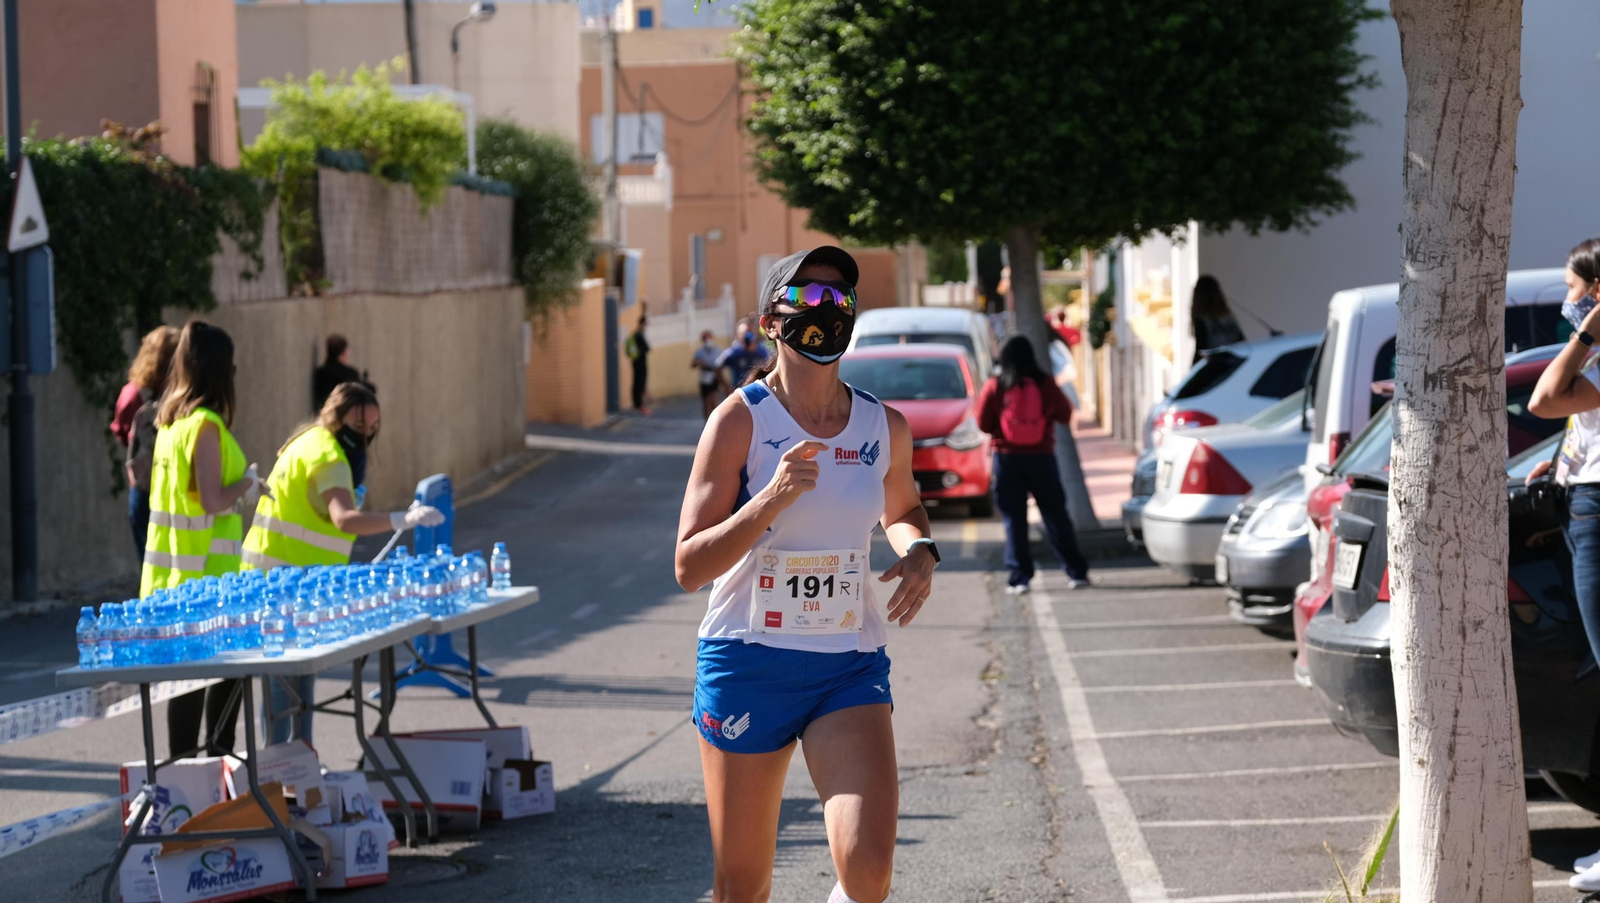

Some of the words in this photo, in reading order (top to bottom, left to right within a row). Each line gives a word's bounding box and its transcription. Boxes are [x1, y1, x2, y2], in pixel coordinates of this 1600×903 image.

[835, 448, 858, 460] Run
[861, 454, 872, 464] 04
[787, 557, 819, 567] CIRCUITO
[812, 566, 839, 574] POPULARES
[786, 575, 834, 598] 191
[803, 601, 820, 611] EVA
[186, 861, 263, 893] Monssalus
